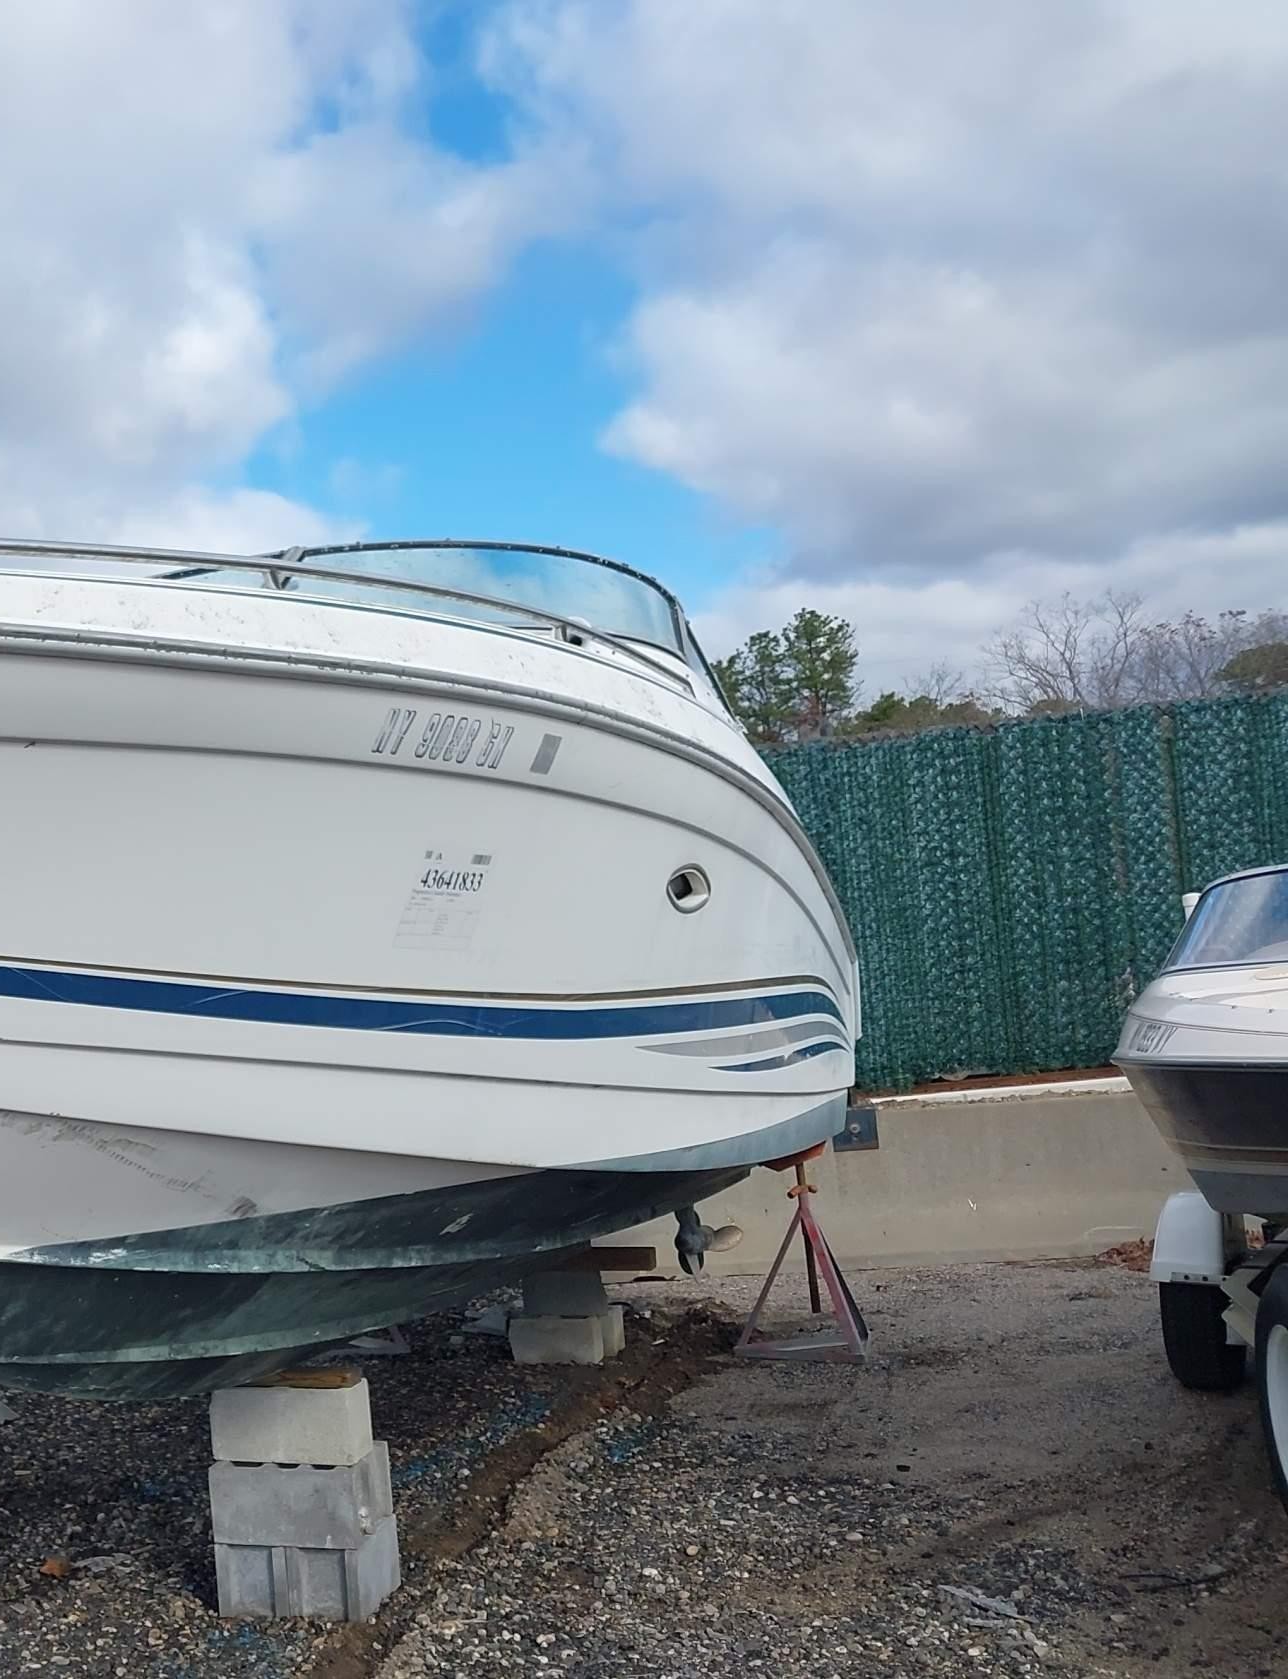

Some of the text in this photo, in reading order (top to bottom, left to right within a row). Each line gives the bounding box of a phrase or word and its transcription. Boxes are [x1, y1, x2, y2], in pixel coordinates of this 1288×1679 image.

[372, 709, 416, 754] NY
[415, 713, 481, 763] 9088
[420, 869, 483, 892] 43641833
